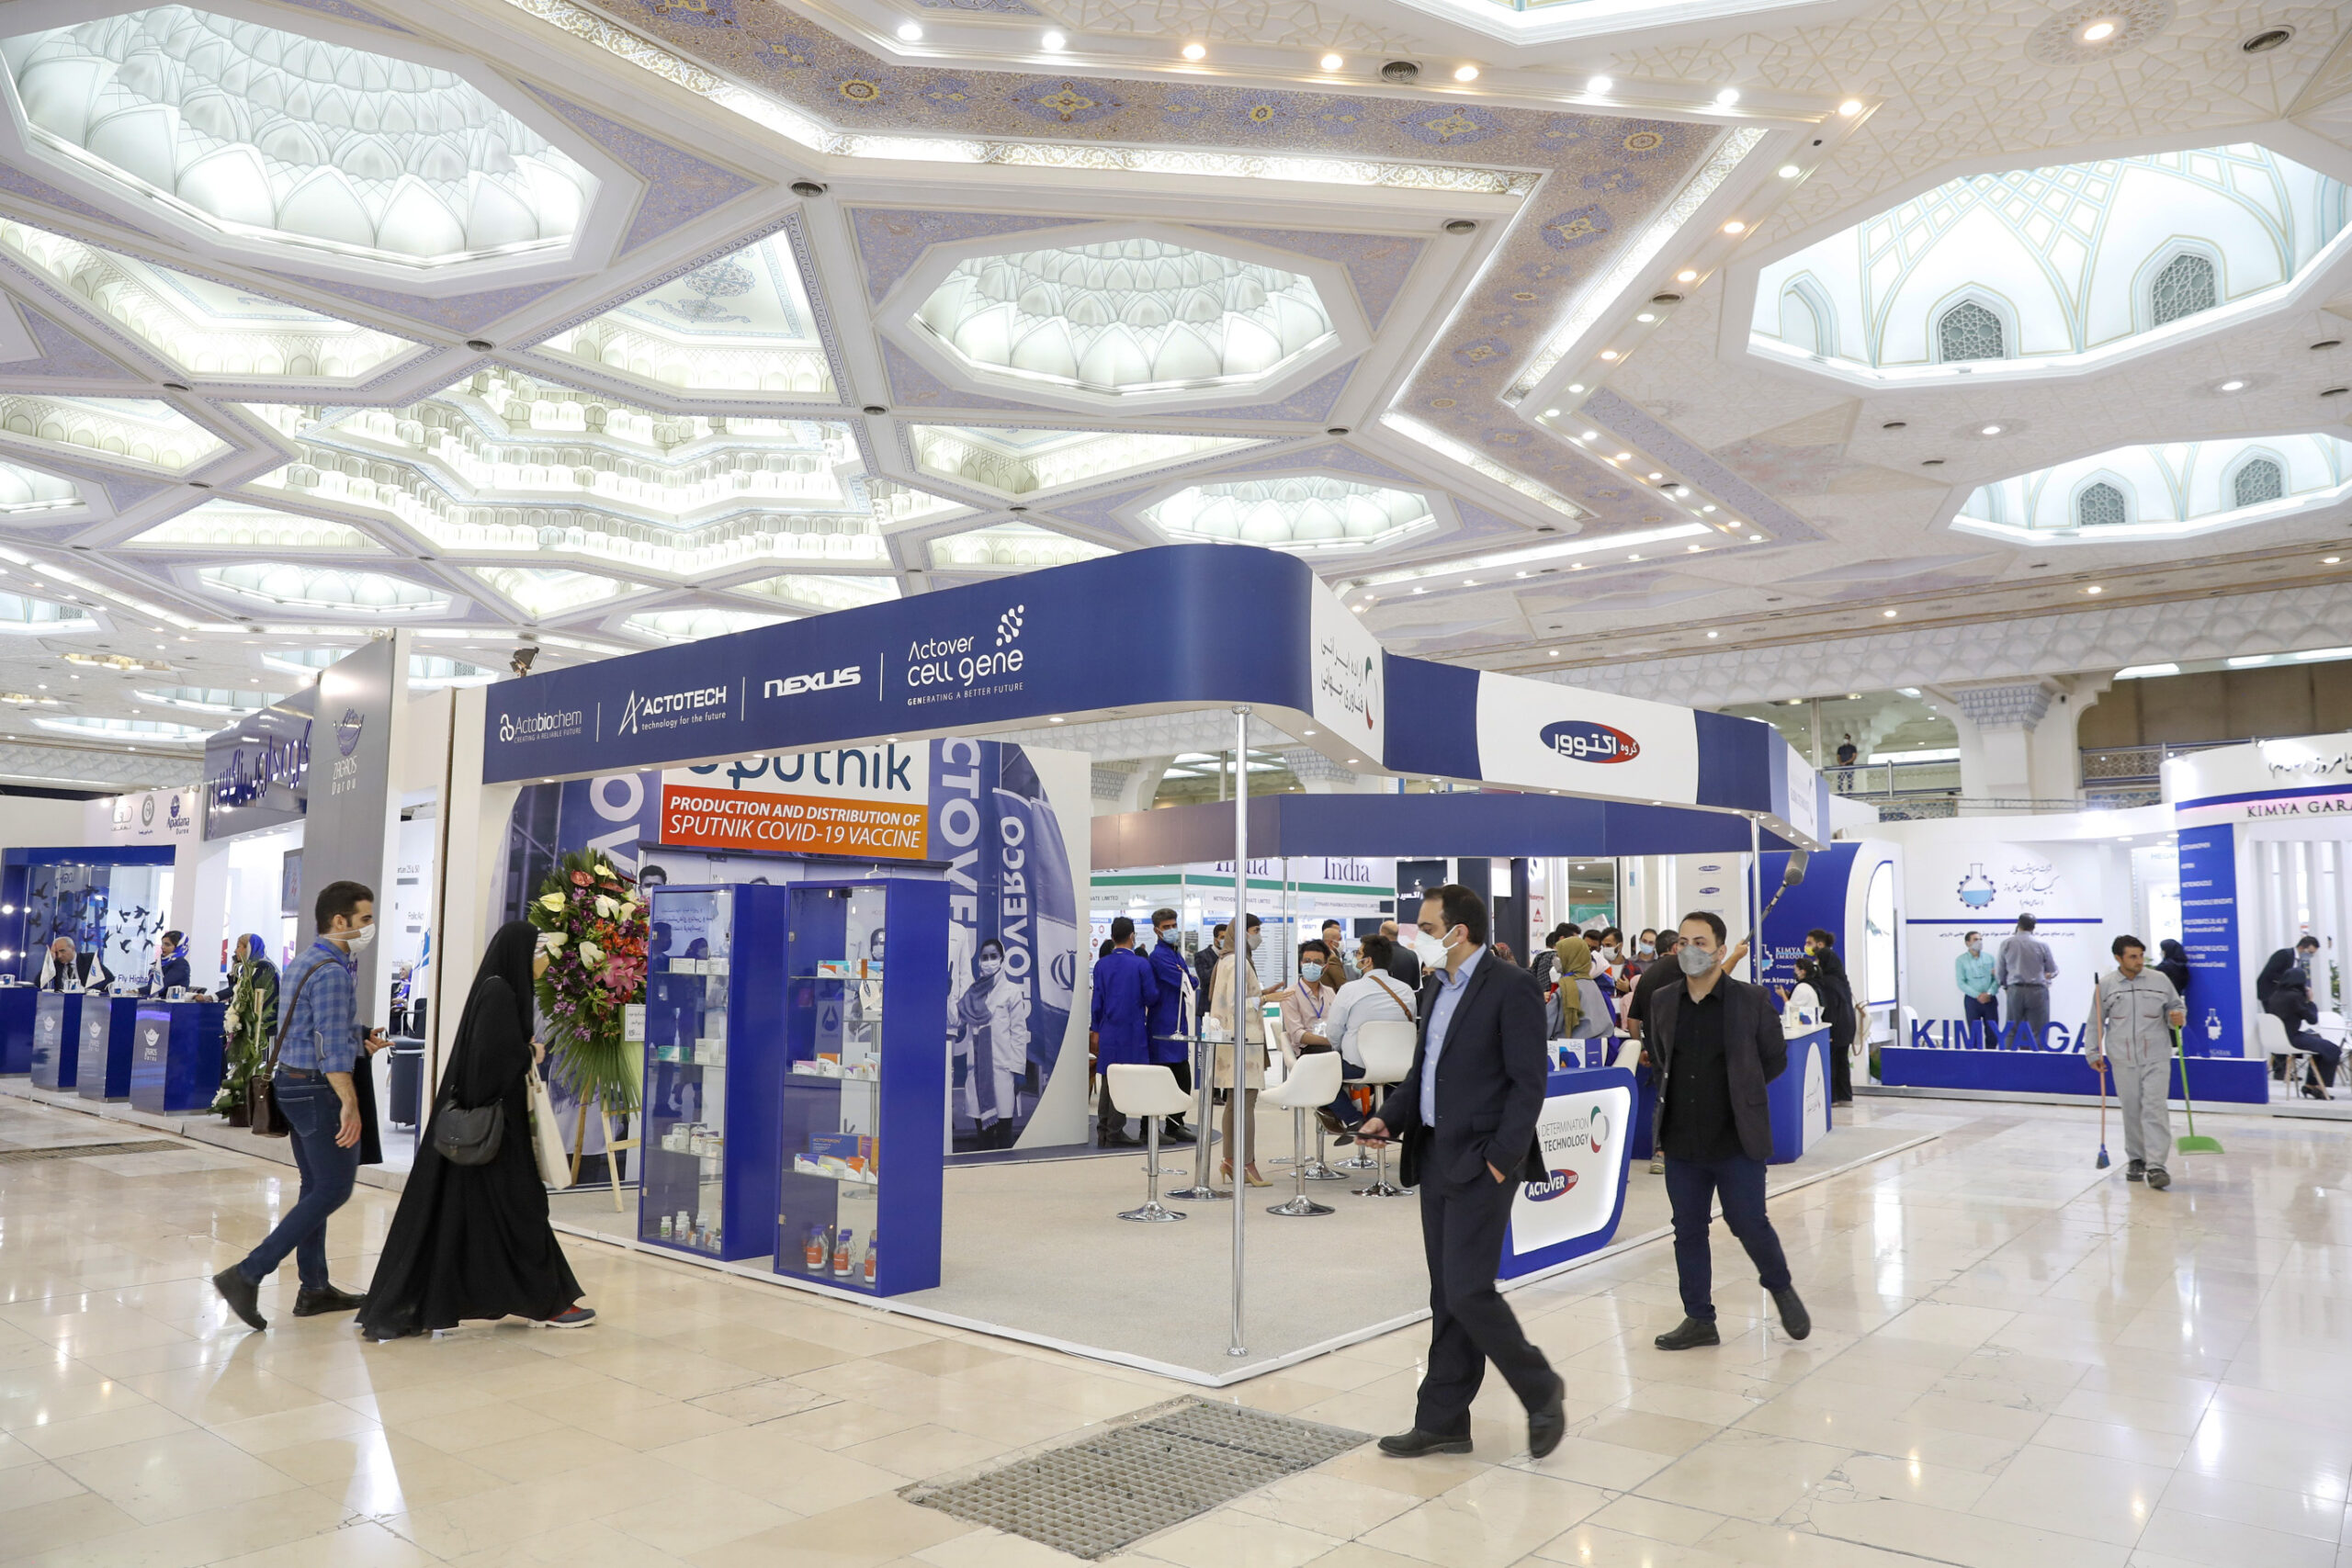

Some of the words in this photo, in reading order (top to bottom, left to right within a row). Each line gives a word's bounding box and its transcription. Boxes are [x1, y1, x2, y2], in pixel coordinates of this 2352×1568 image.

[908, 636, 974, 662] Actover
[907, 660, 954, 687] cell
[958, 649, 1023, 687] gene
[643, 685, 727, 716] ACTOTECH
[907, 691, 954, 706] GENERATING
[956, 690, 961, 699] A
[964, 686, 991, 698] BETTER
[994, 682, 1024, 694] FUTURE
[514, 710, 582, 735] Actobiochem
[641, 716, 678, 731] technology
[679, 716, 689, 726] for
[692, 714, 702, 724] the
[705, 710, 727, 722] future
[514, 734, 536, 744] CREATING
[541, 731, 562, 740] RELIABLE
[563, 728, 582, 738] FUTURE
[1555, 732, 1618, 757] اکتوور
[1620, 742, 1638, 757] گروه
[670, 795, 770, 816] PRODUCTION
[772, 804, 805, 818] AND
[806, 807, 900, 825] DISTRIBUTION
[902, 813, 922, 827] OF
[2247, 802, 2301, 818] KIMYA
[669, 814, 754, 839] SPUTNIK
[757, 819, 844, 844] COVID-19
[849, 826, 922, 849] VACCINE
[119, 974, 127, 983] Fly
[1542, 1117, 1589, 1137] DETERMINATION
[1544, 1133, 1589, 1153] TECHNOLOGY
[1528, 1175, 1566, 1198] ACTOVER
